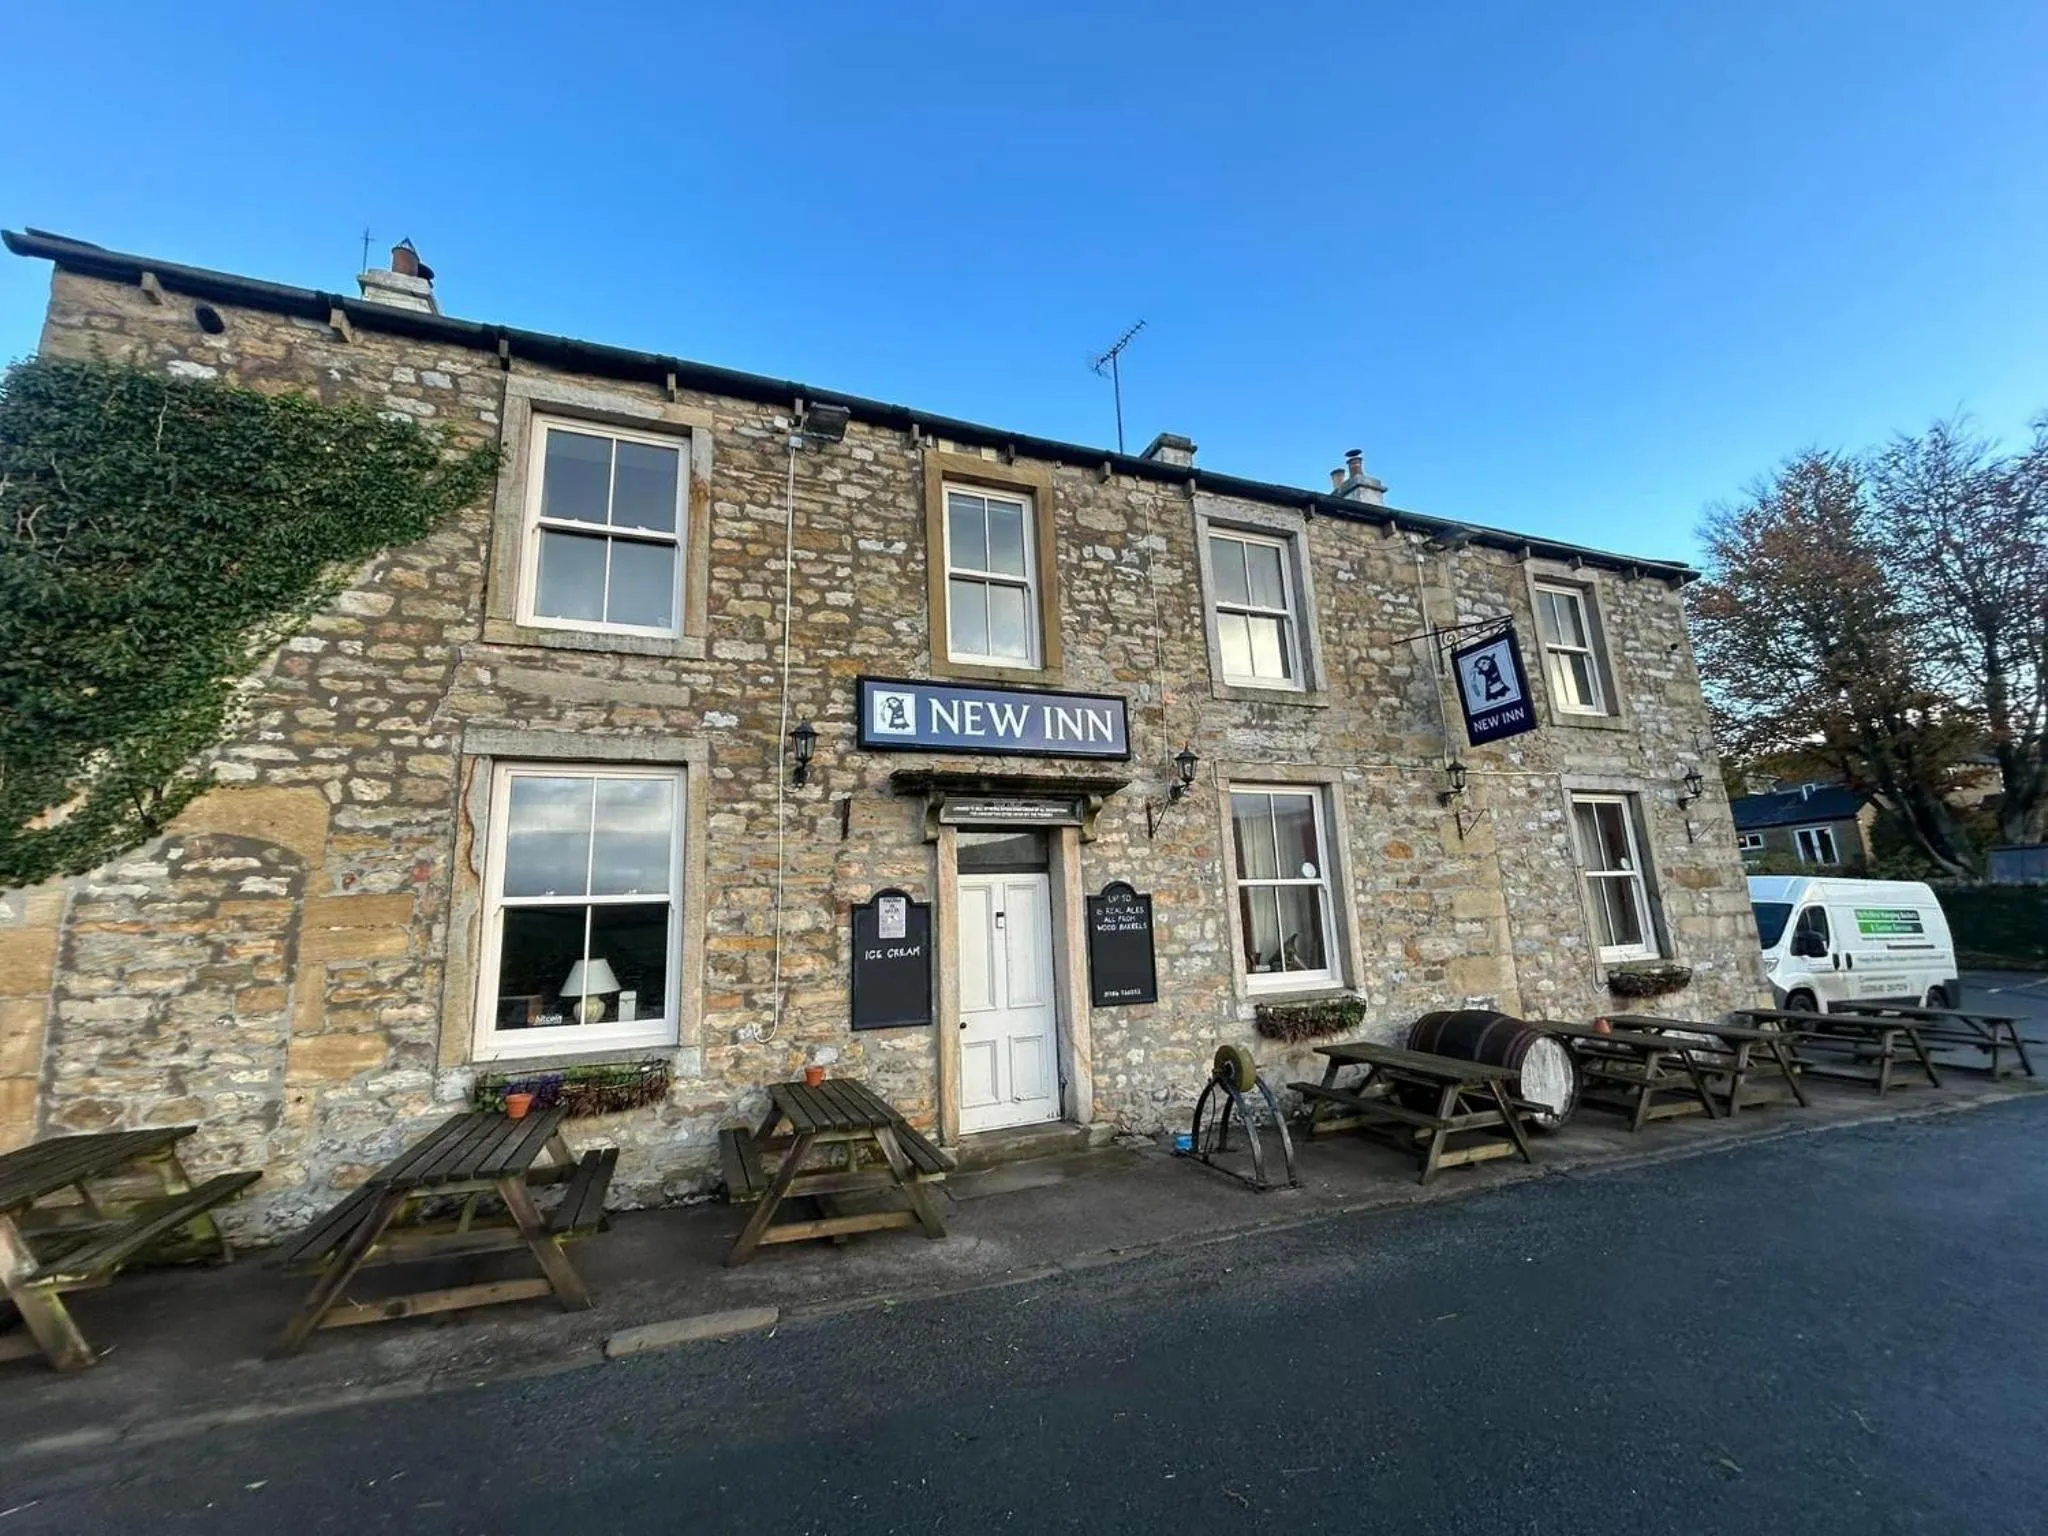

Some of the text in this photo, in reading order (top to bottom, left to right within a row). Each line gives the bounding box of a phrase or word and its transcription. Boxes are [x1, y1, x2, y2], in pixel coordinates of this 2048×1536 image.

[928, 698, 1114, 742] NEW INN
[1473, 708, 1525, 732] NEW INN
[1105, 907, 1124, 915] REAL
[1126, 906, 1145, 914] ALES
[1118, 915, 1136, 923] FROM
[1096, 922, 1148, 931] WOOD BARRELS
[865, 945, 920, 960] ICE CREAM
